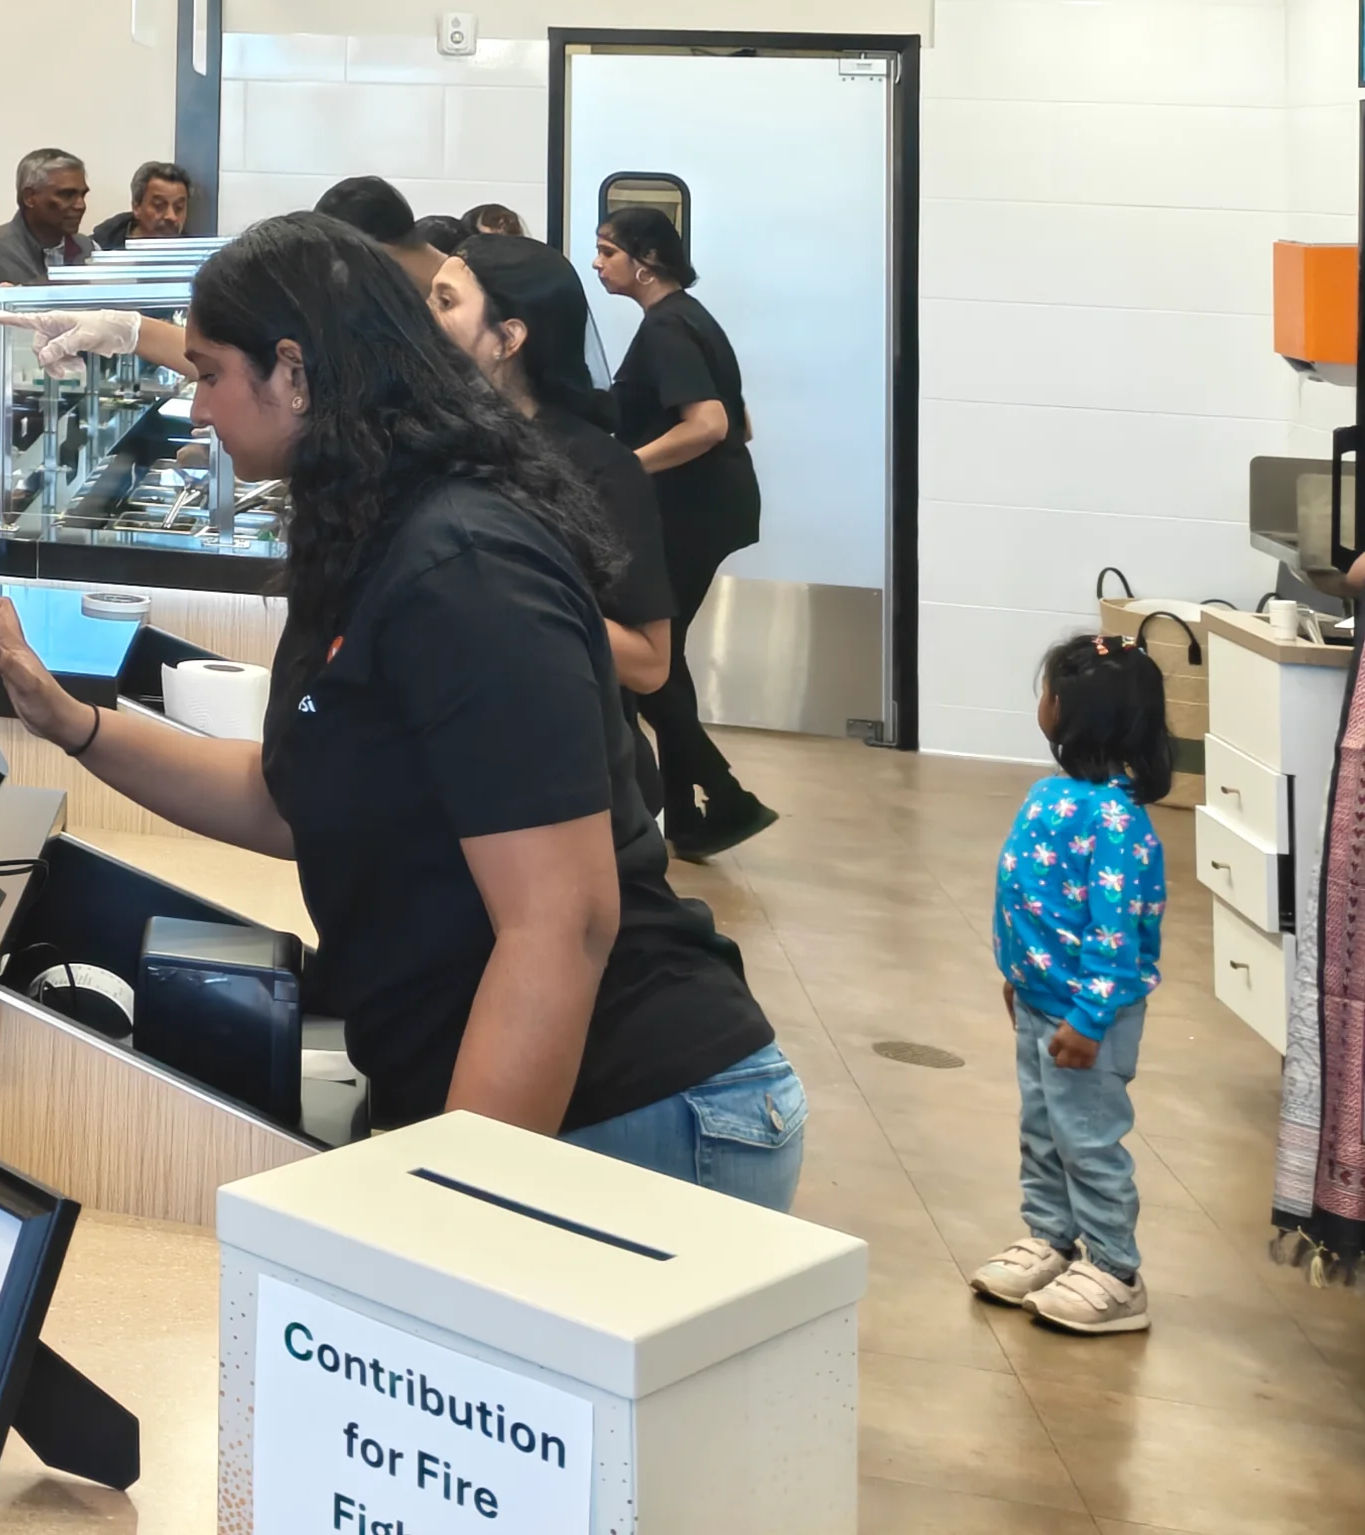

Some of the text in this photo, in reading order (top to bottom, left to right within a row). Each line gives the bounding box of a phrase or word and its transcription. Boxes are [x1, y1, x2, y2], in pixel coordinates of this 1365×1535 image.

[284, 1321, 566, 1469] Contribution
[343, 1421, 499, 1520] for Fire
